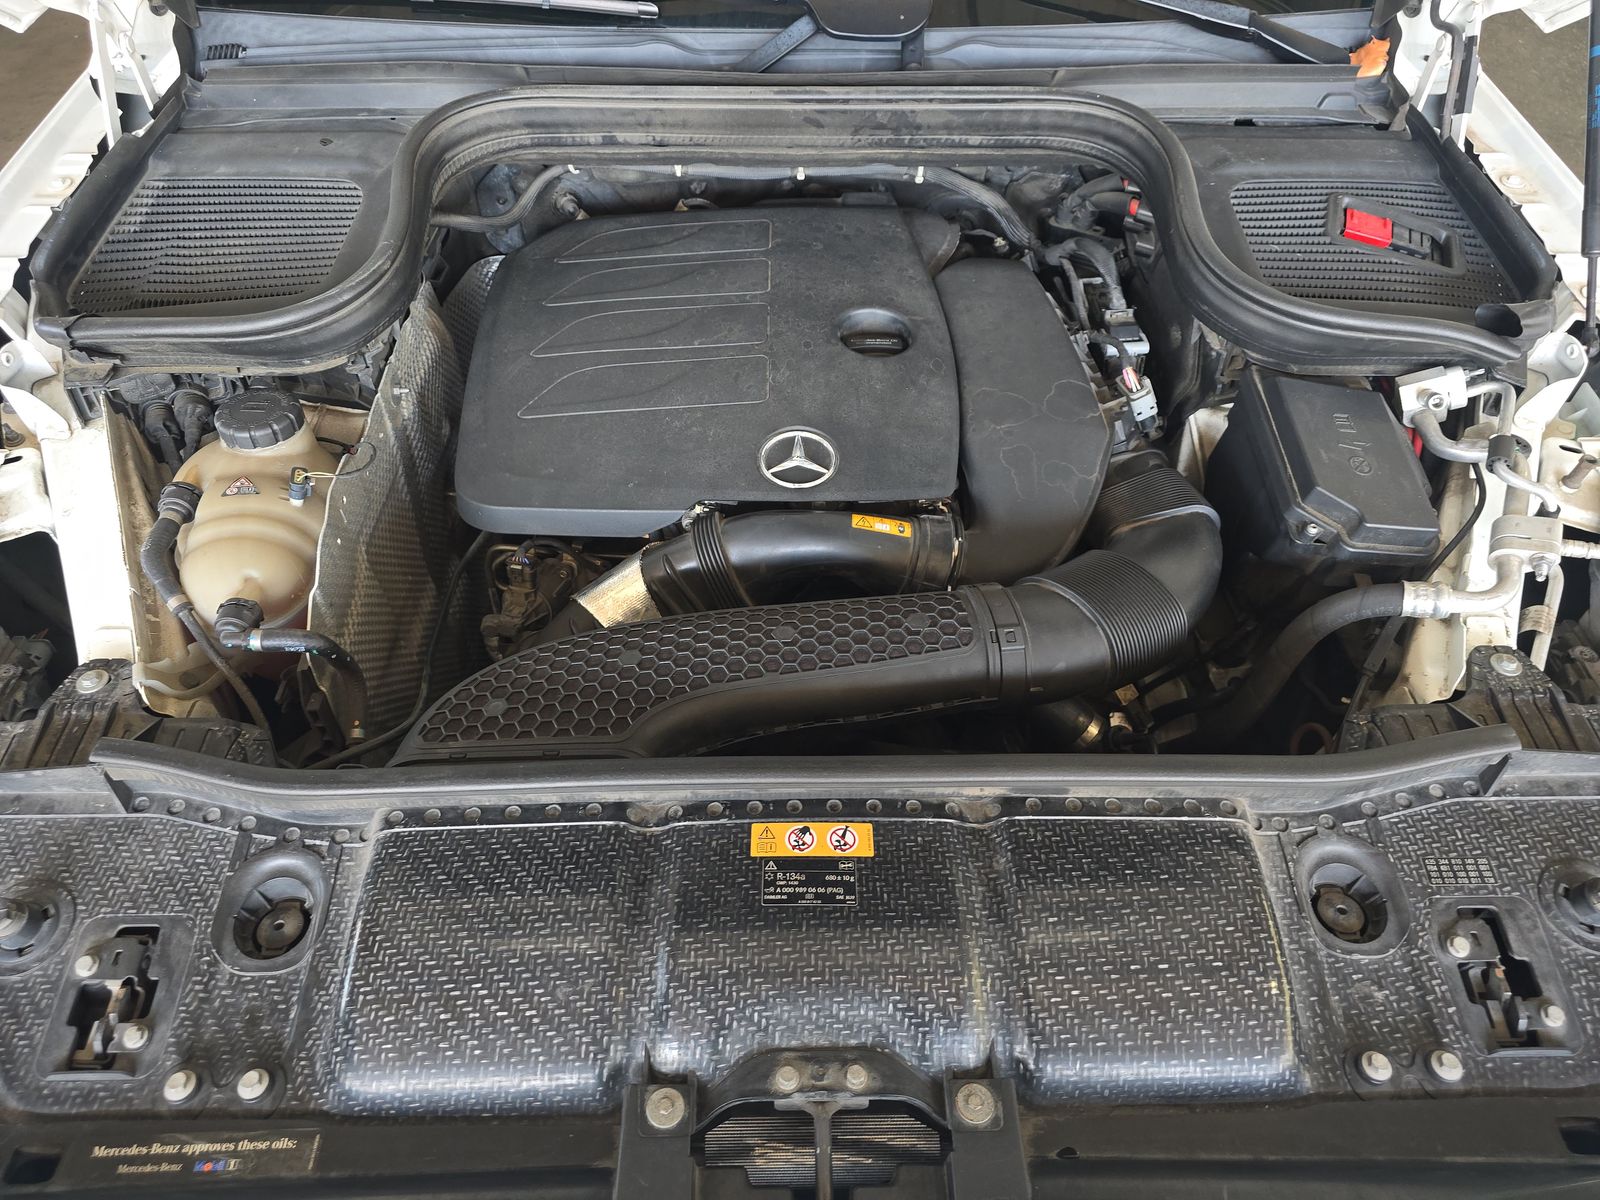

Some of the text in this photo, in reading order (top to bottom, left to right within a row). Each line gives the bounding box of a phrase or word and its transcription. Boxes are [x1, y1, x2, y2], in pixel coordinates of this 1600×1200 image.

[776, 872, 806, 880] R-134a
[90, 1138, 298, 1158] Mercedes-Benz approves these oils:
[116, 1162, 183, 1174] Mercedes-Benz
